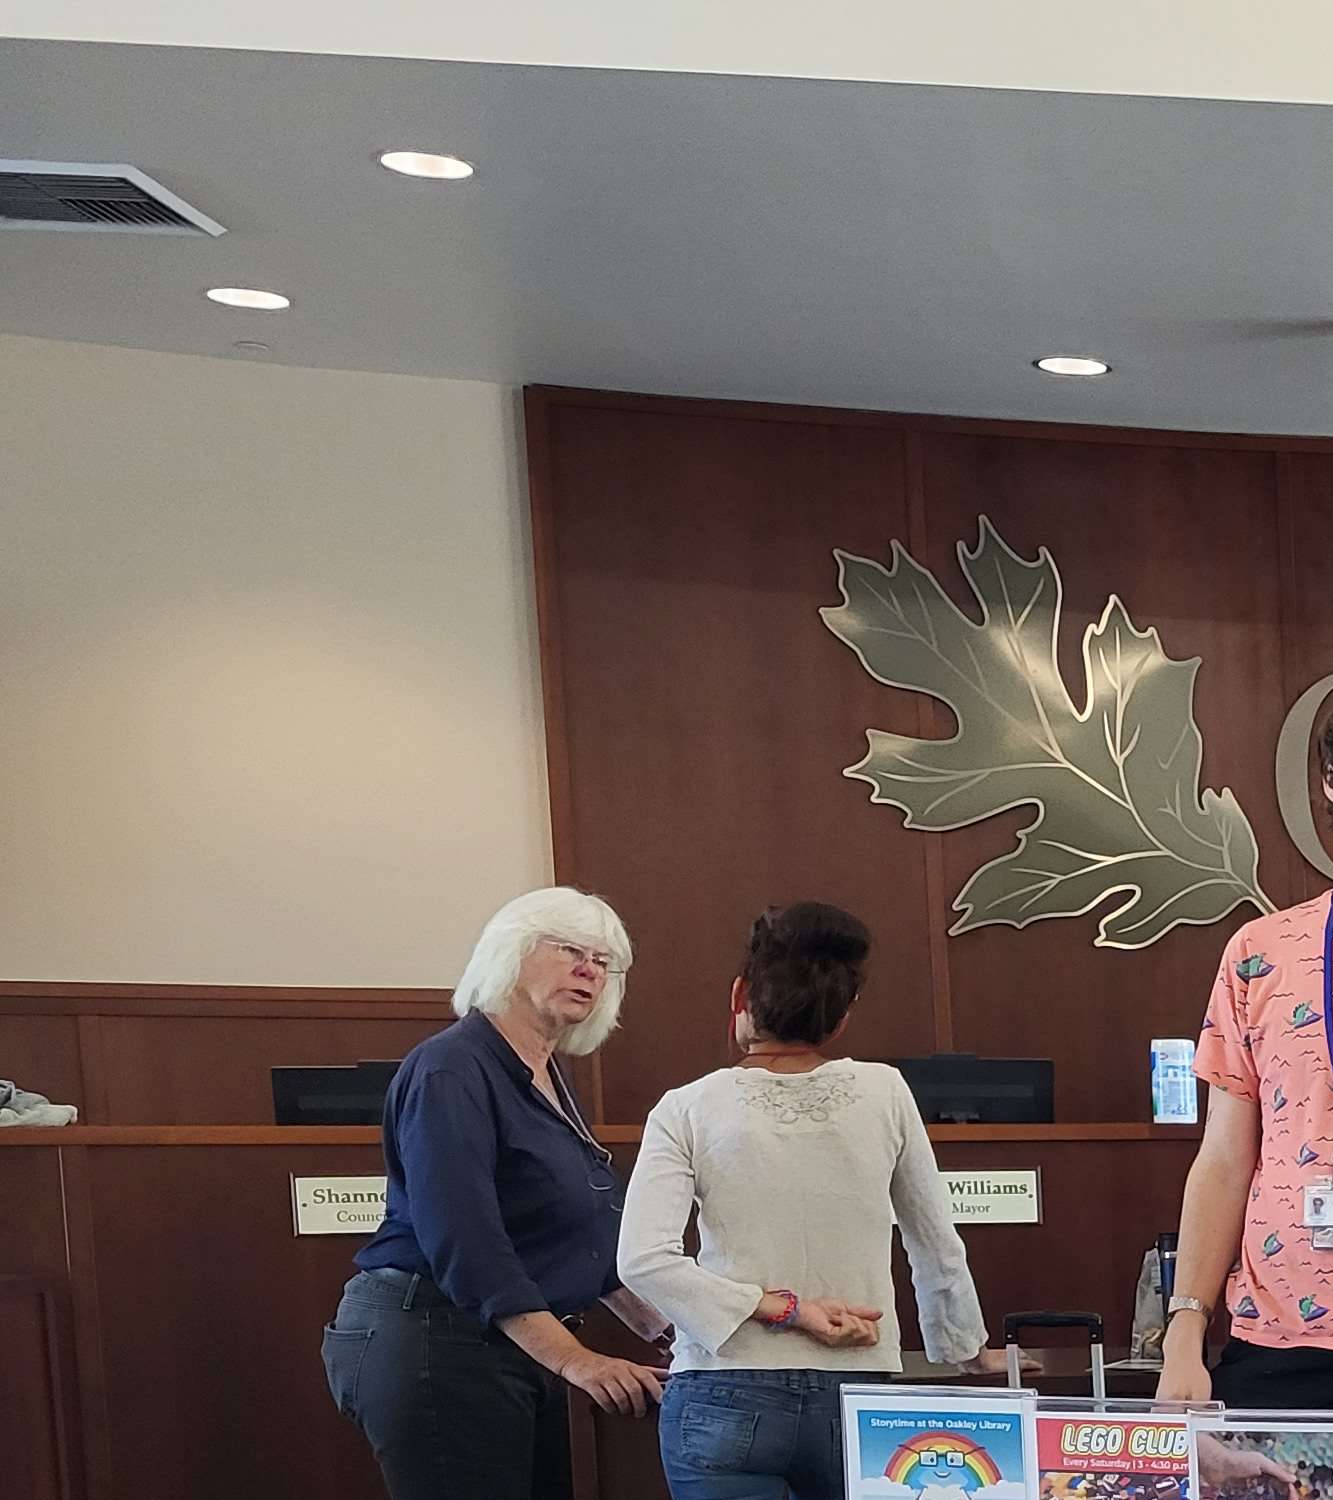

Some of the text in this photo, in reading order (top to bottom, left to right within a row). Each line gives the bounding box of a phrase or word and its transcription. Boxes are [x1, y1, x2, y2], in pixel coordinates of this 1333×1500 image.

[947, 1180, 1028, 1195] Williams
[951, 1202, 991, 1215] Mayor
[871, 1418, 915, 1428] Storytime
[928, 1420, 943, 1428] the
[945, 1421, 977, 1431] Oakley
[979, 1421, 1011, 1432] Library
[1062, 1424, 1188, 1458] LEGO CLUB
[1063, 1457, 1088, 1467] Every
[1090, 1459, 1131, 1470] Saturday
